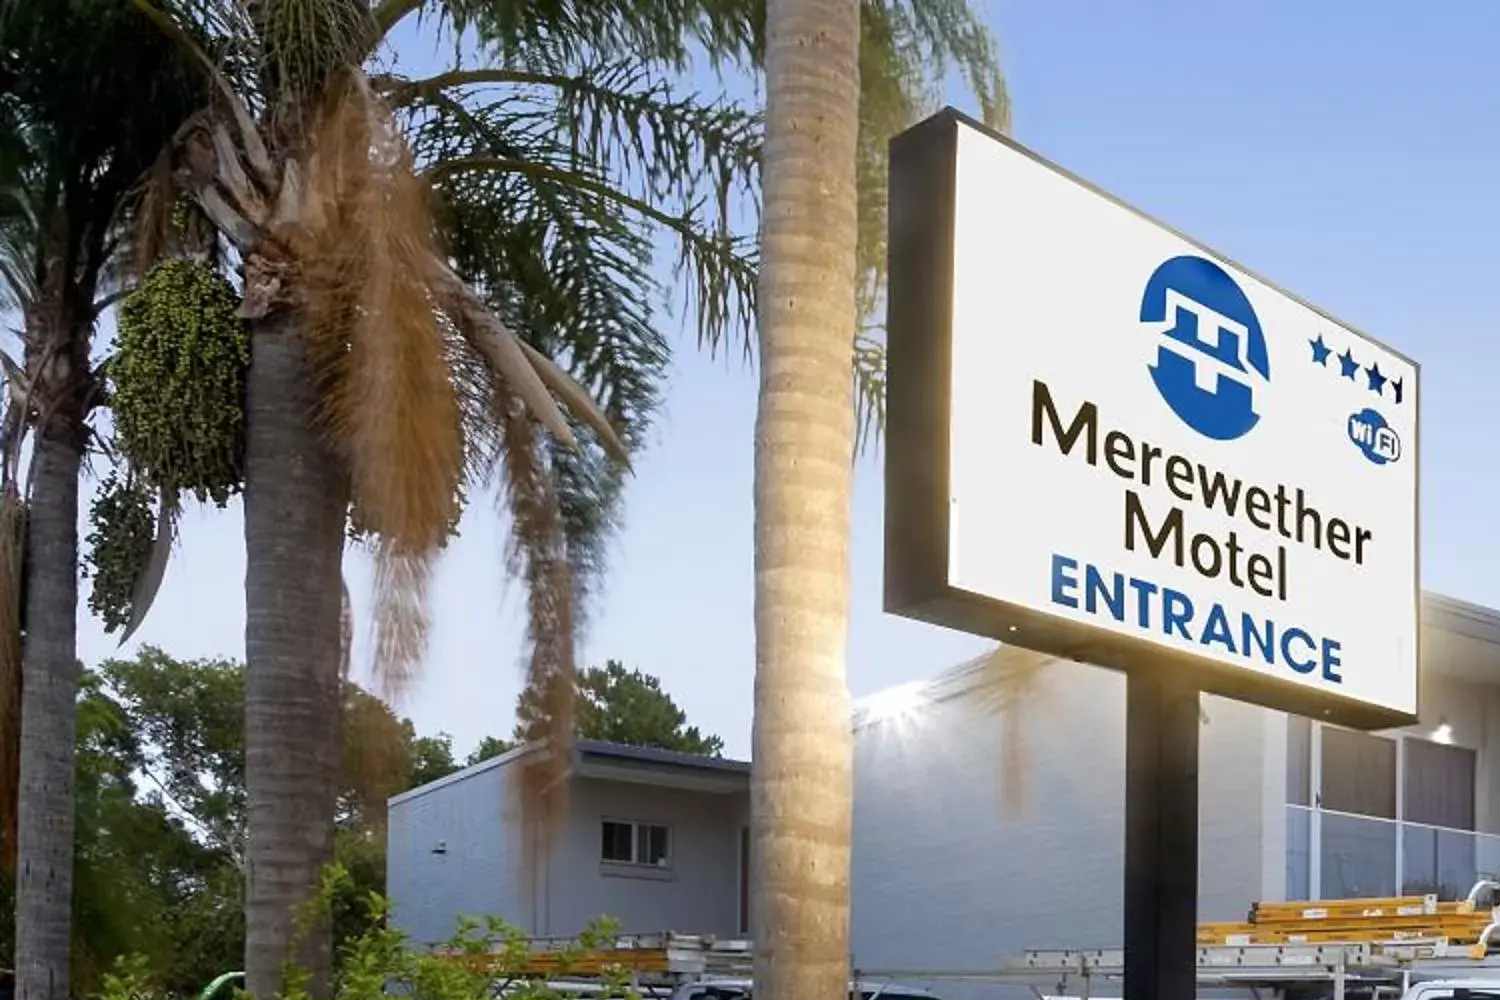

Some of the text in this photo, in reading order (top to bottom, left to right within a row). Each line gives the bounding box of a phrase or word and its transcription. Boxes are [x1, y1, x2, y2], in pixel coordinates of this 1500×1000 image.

[1031, 379, 1372, 565] Merewether
[1124, 490, 1288, 601] Motel
[1050, 553, 1343, 683] ENTRANCE
